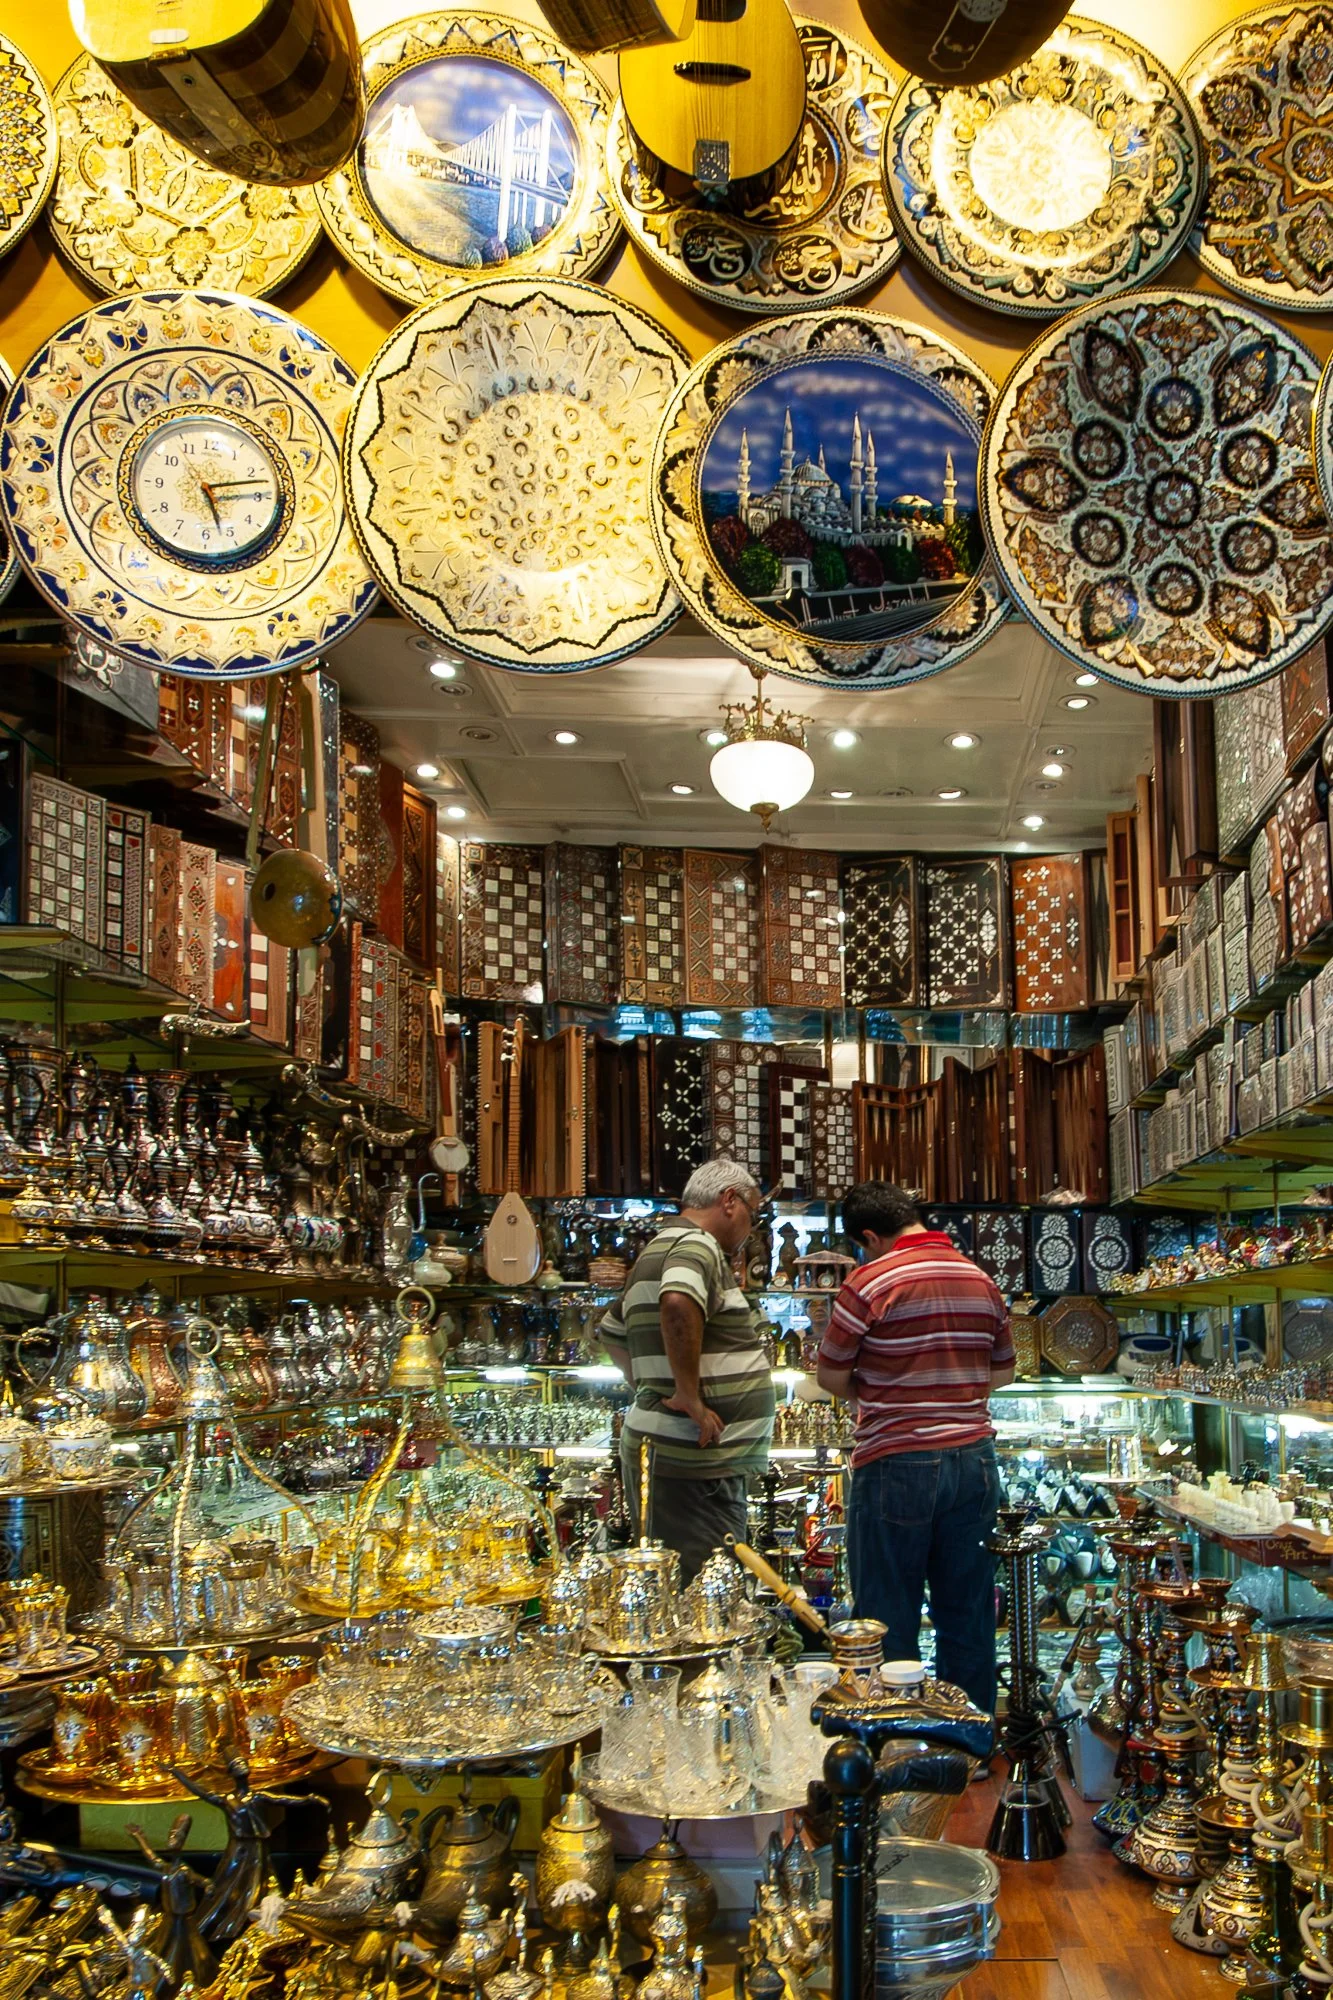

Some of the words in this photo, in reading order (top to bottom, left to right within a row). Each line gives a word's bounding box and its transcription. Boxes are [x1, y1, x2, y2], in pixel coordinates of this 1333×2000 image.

[183, 443, 195, 455] 11
[203, 439, 219, 451] 12
[164, 455, 179, 467] 10
[247, 467, 255, 478] 2
[155, 477, 164, 488] 9
[253, 491, 262, 502] 3
[160, 502, 169, 513] 8
[176, 519, 184, 530] 7
[244, 514, 252, 525] 4
[201, 529, 210, 540] 6
[226, 526, 234, 537] 5
